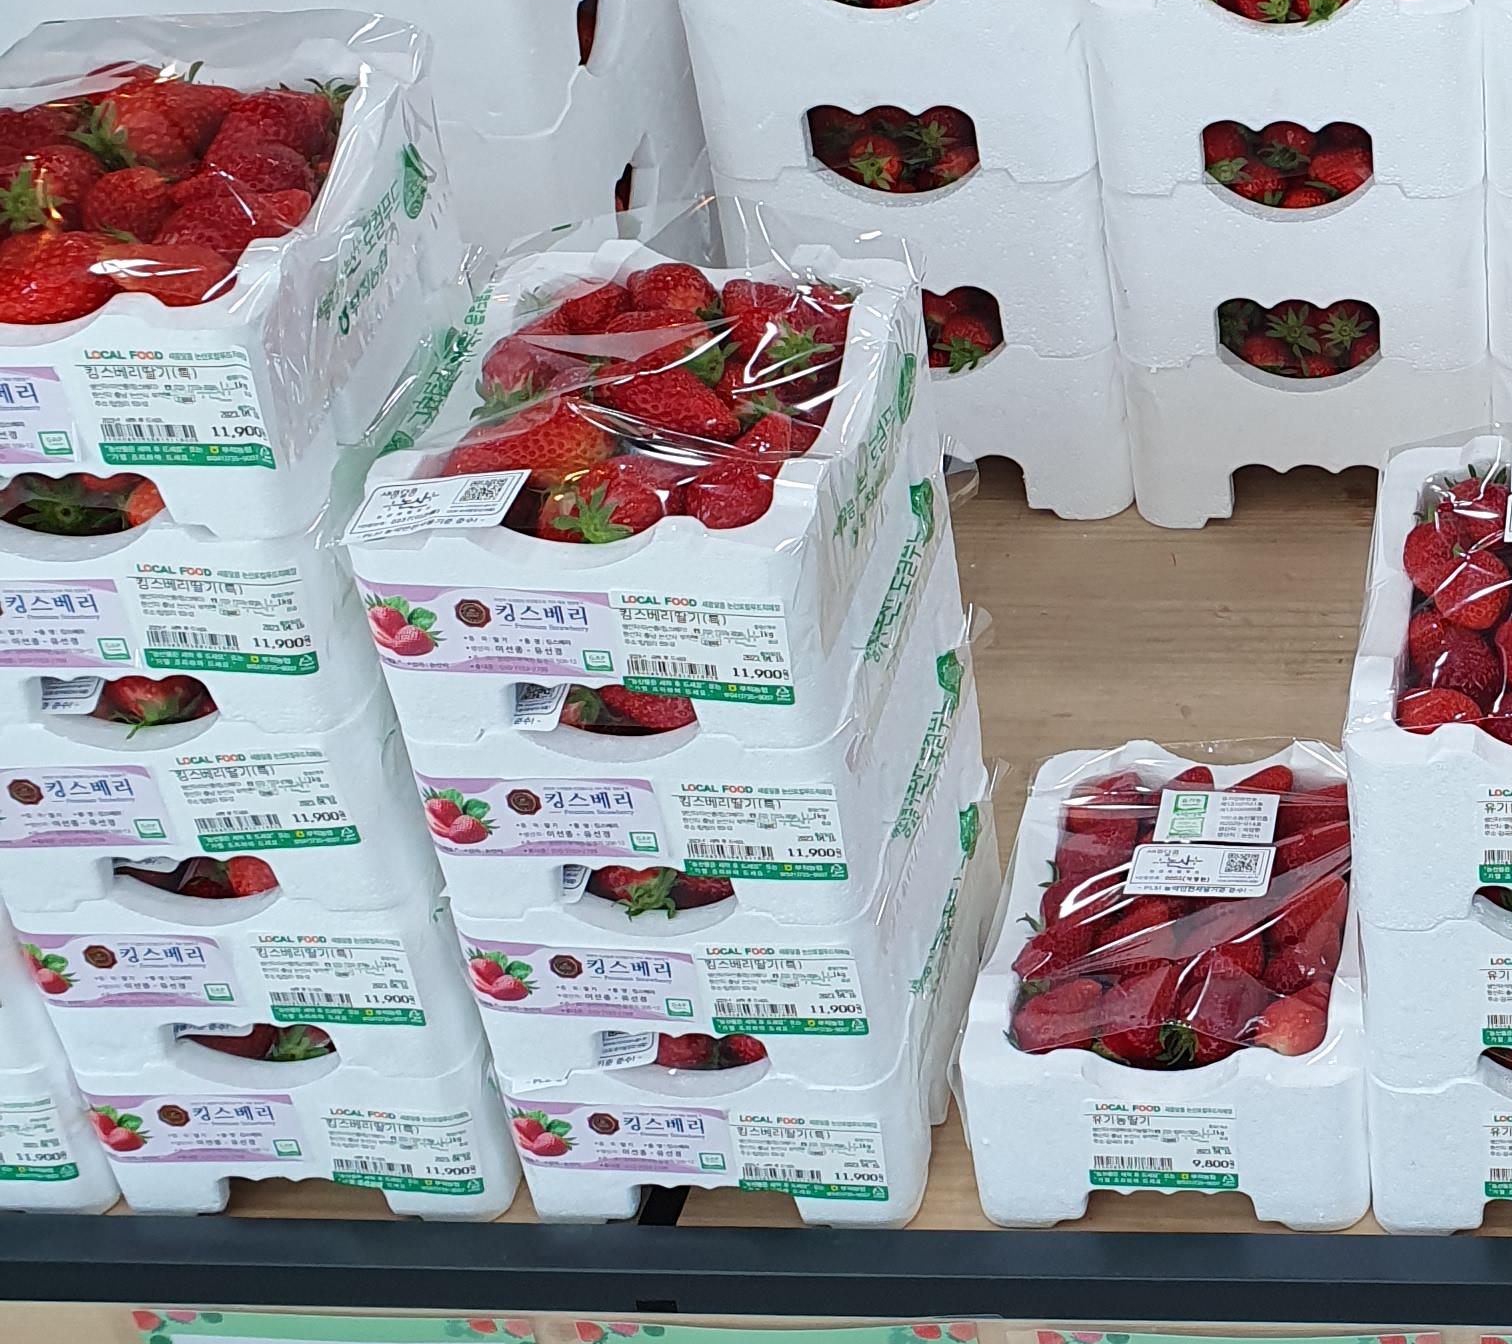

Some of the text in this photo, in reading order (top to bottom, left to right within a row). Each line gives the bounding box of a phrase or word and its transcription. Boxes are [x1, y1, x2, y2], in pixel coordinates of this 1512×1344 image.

[83, 350, 163, 360] LOCAL FOOD
[136, 563, 212, 577] LOCAL FOOD
[5, 594, 99, 614] 킹스베리
[621, 595, 697, 607] LOCAL FOOD
[494, 603, 588, 626] 킹스베리
[176, 754, 246, 766] LOCAL FOOD
[45, 777, 135, 798] 킹스베리
[681, 783, 753, 794] LOCAL FOOD
[545, 790, 634, 810] 킹스베리
[258, 934, 327, 944] LOCAL FOOD
[119, 945, 206, 963] 킹스베리
[706, 947, 742, 955] LOCAL
[587, 958, 672, 979] 킹스베리
[192, 1104, 276, 1123] 킹스베리
[328, 1107, 396, 1120] LOCAL FOOD
[1132, 1104, 1161, 1112] FOOD
[623, 1116, 705, 1135] 킹스베리
[739, 1115, 805, 1125] LOCAL FOOD
[1093, 1115, 1151, 1126] 유기농딸기
